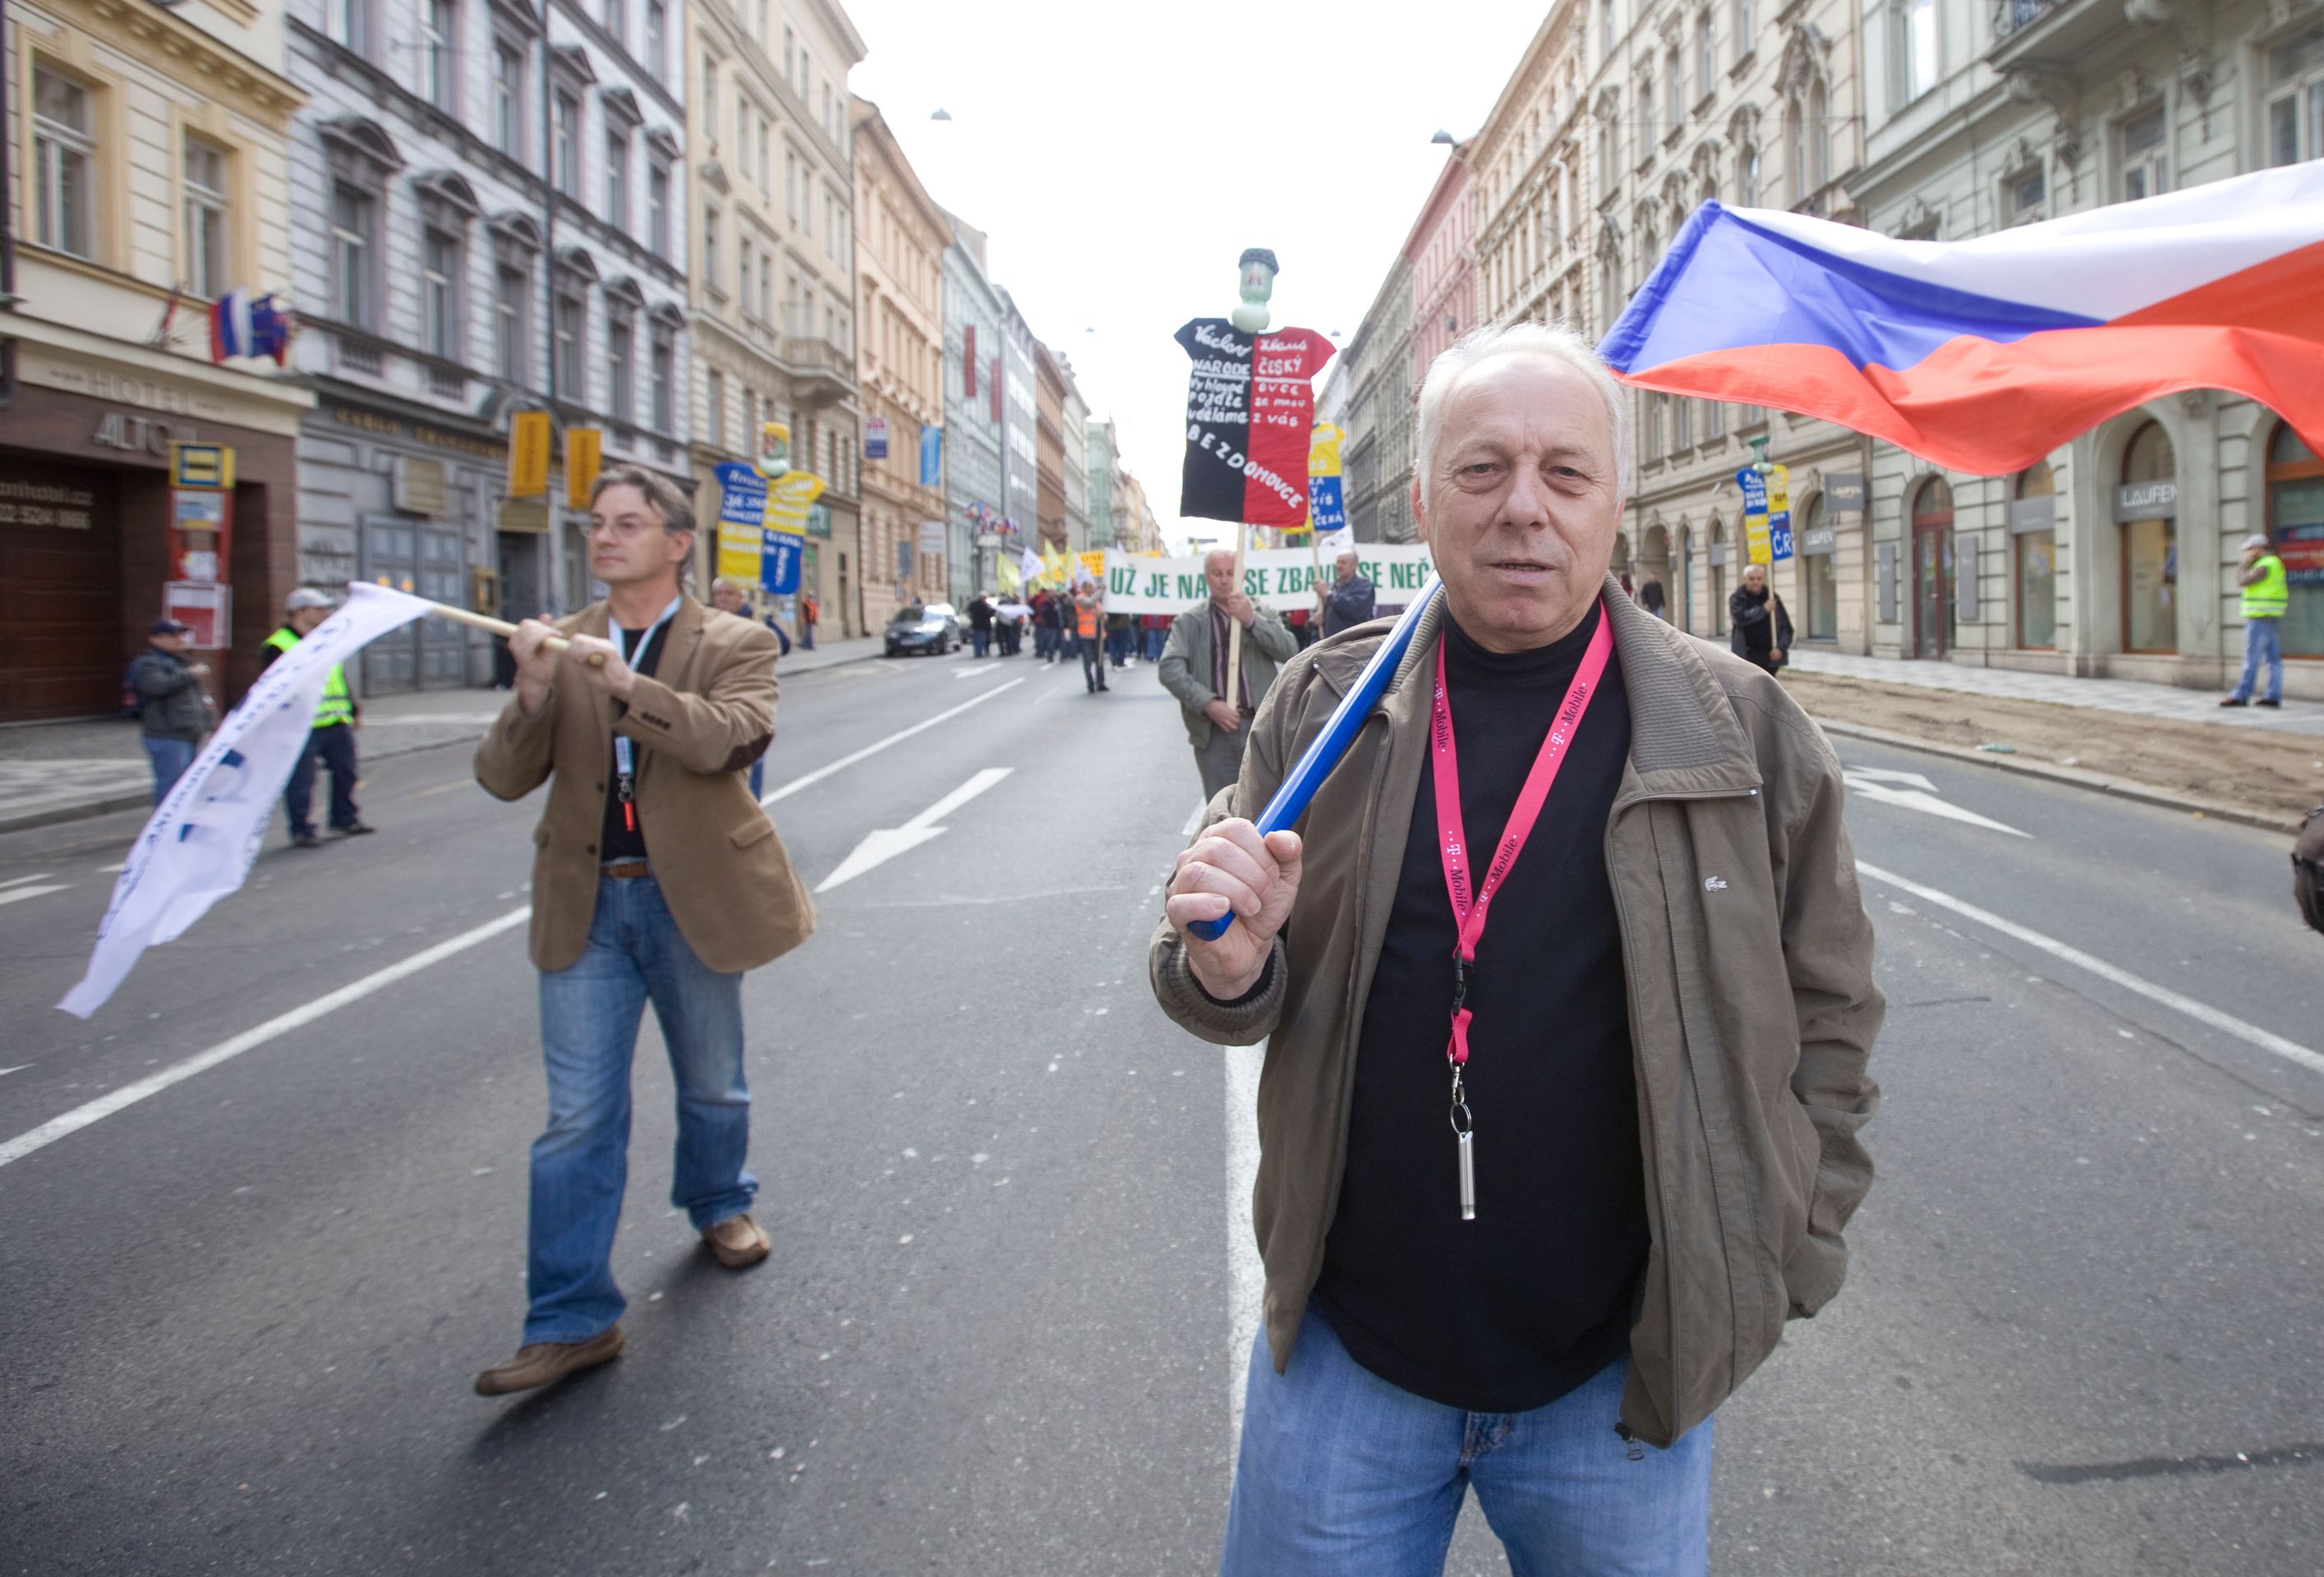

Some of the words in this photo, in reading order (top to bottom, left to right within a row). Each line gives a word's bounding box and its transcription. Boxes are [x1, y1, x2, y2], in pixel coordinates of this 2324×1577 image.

[1259, 338, 1308, 352] Klaus
[1193, 355, 1251, 375] NÁRODE
[1258, 354, 1303, 375] ČESKÝ
[1254, 397, 1268, 407] za
[1274, 398, 1306, 407] mnou
[1268, 411, 1299, 427] vás
[1187, 423, 1305, 509] BEZDOMOVCE
[1314, 510, 1343, 527] ČEKÁ
[1772, 531, 1792, 555] ČR
[1110, 563, 1137, 596] UŽ
[1144, 573, 1170, 598] JE
[1358, 562, 1383, 589] SE
